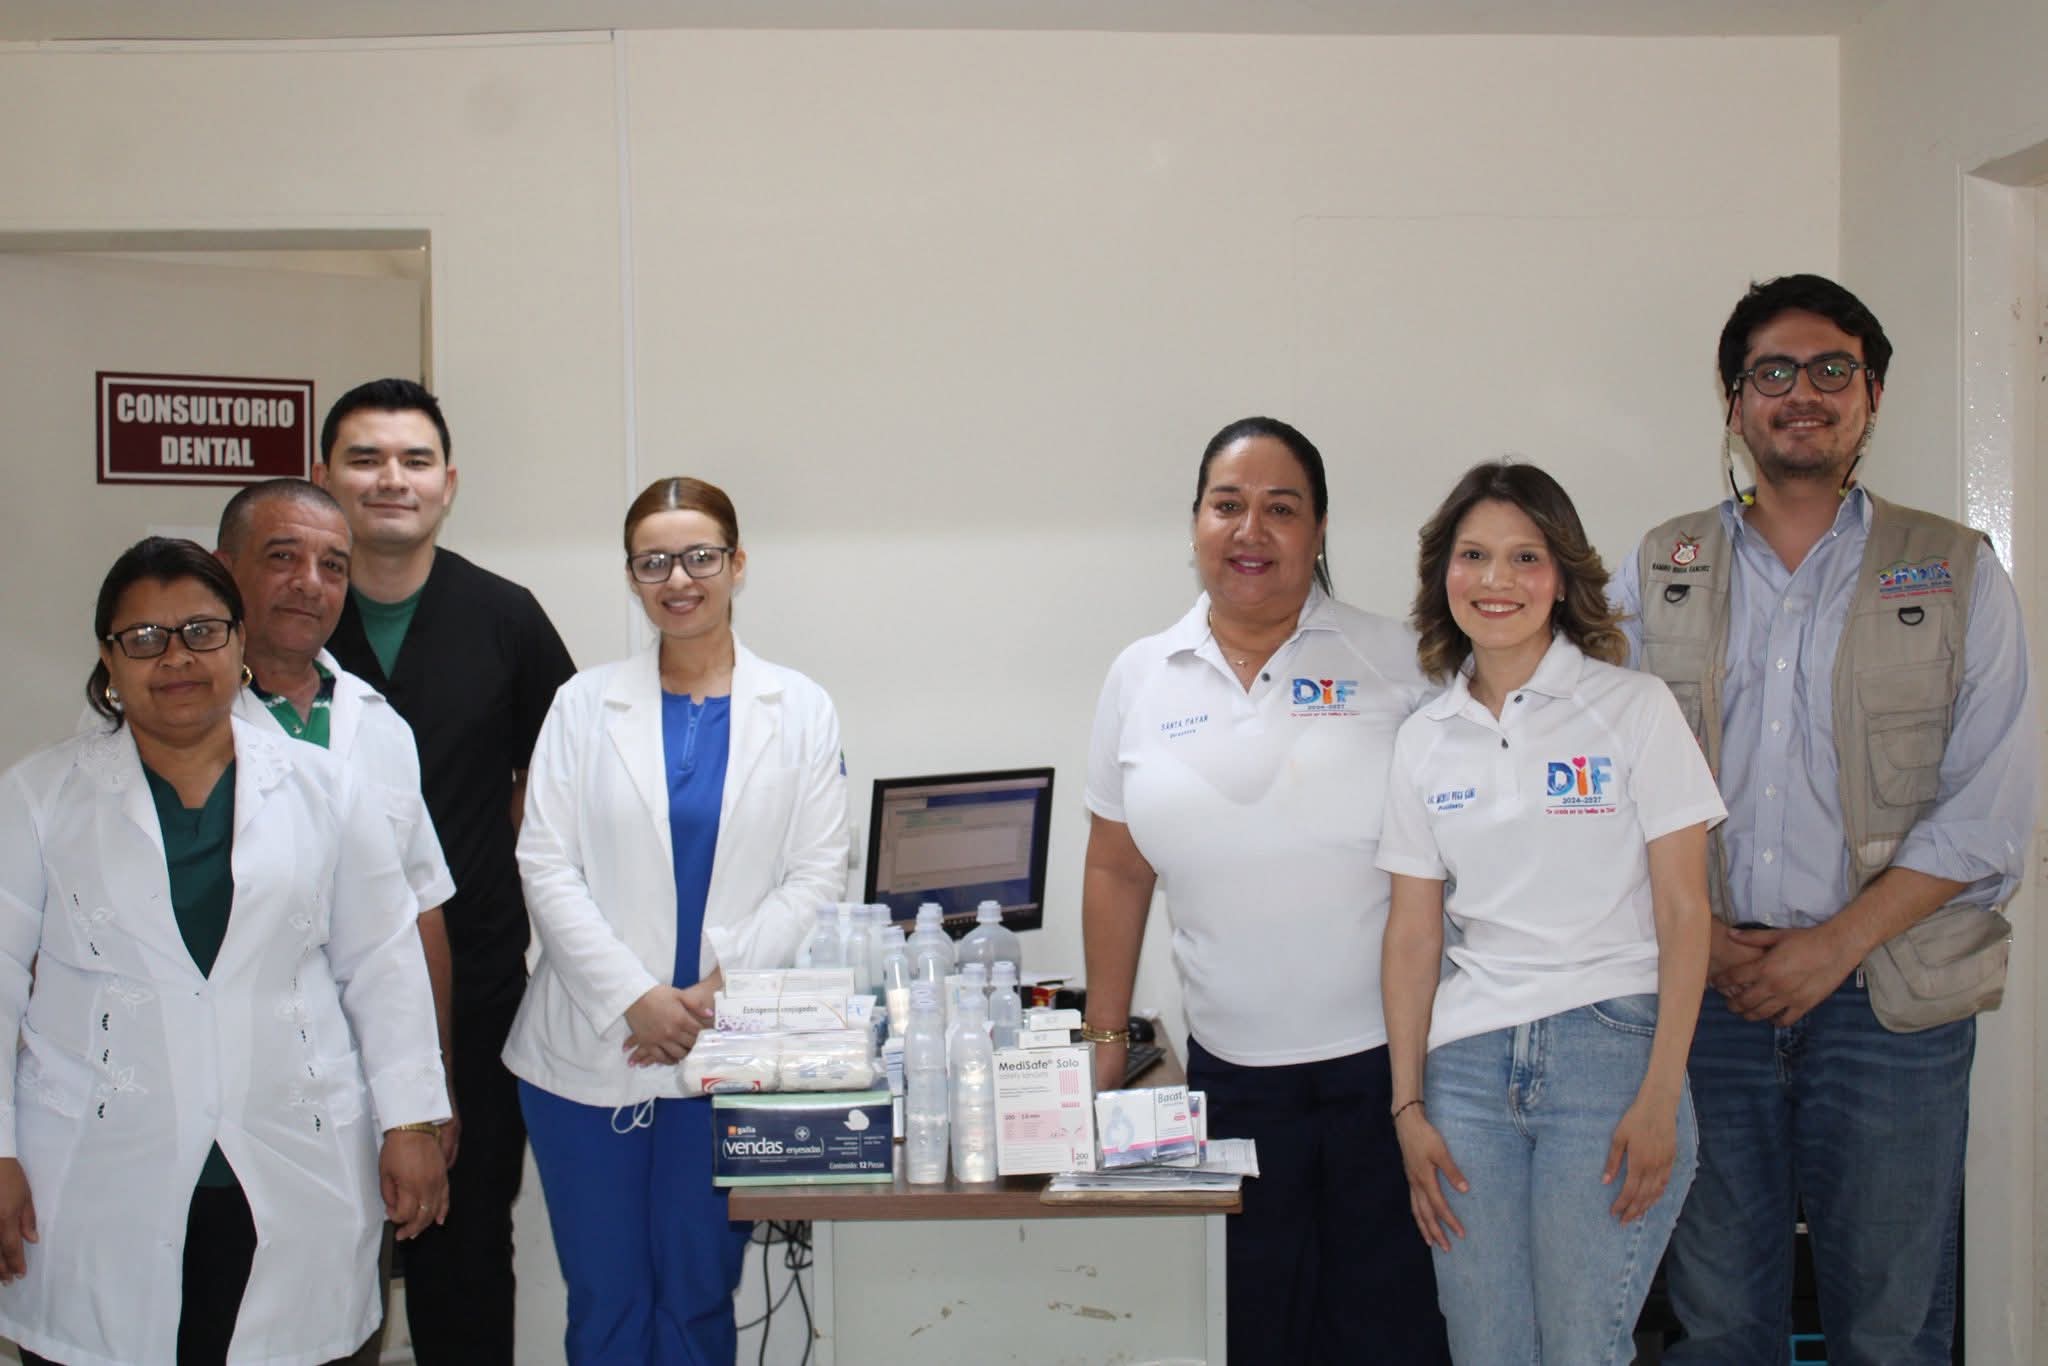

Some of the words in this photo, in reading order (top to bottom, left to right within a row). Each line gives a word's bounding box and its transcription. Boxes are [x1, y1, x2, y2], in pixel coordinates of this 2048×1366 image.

[116, 392, 296, 428] CONSULTORIO
[160, 435, 255, 467] DENTAL
[1056, 1058, 1080, 1069] Solo
[858, 1161, 868, 1169] 12
